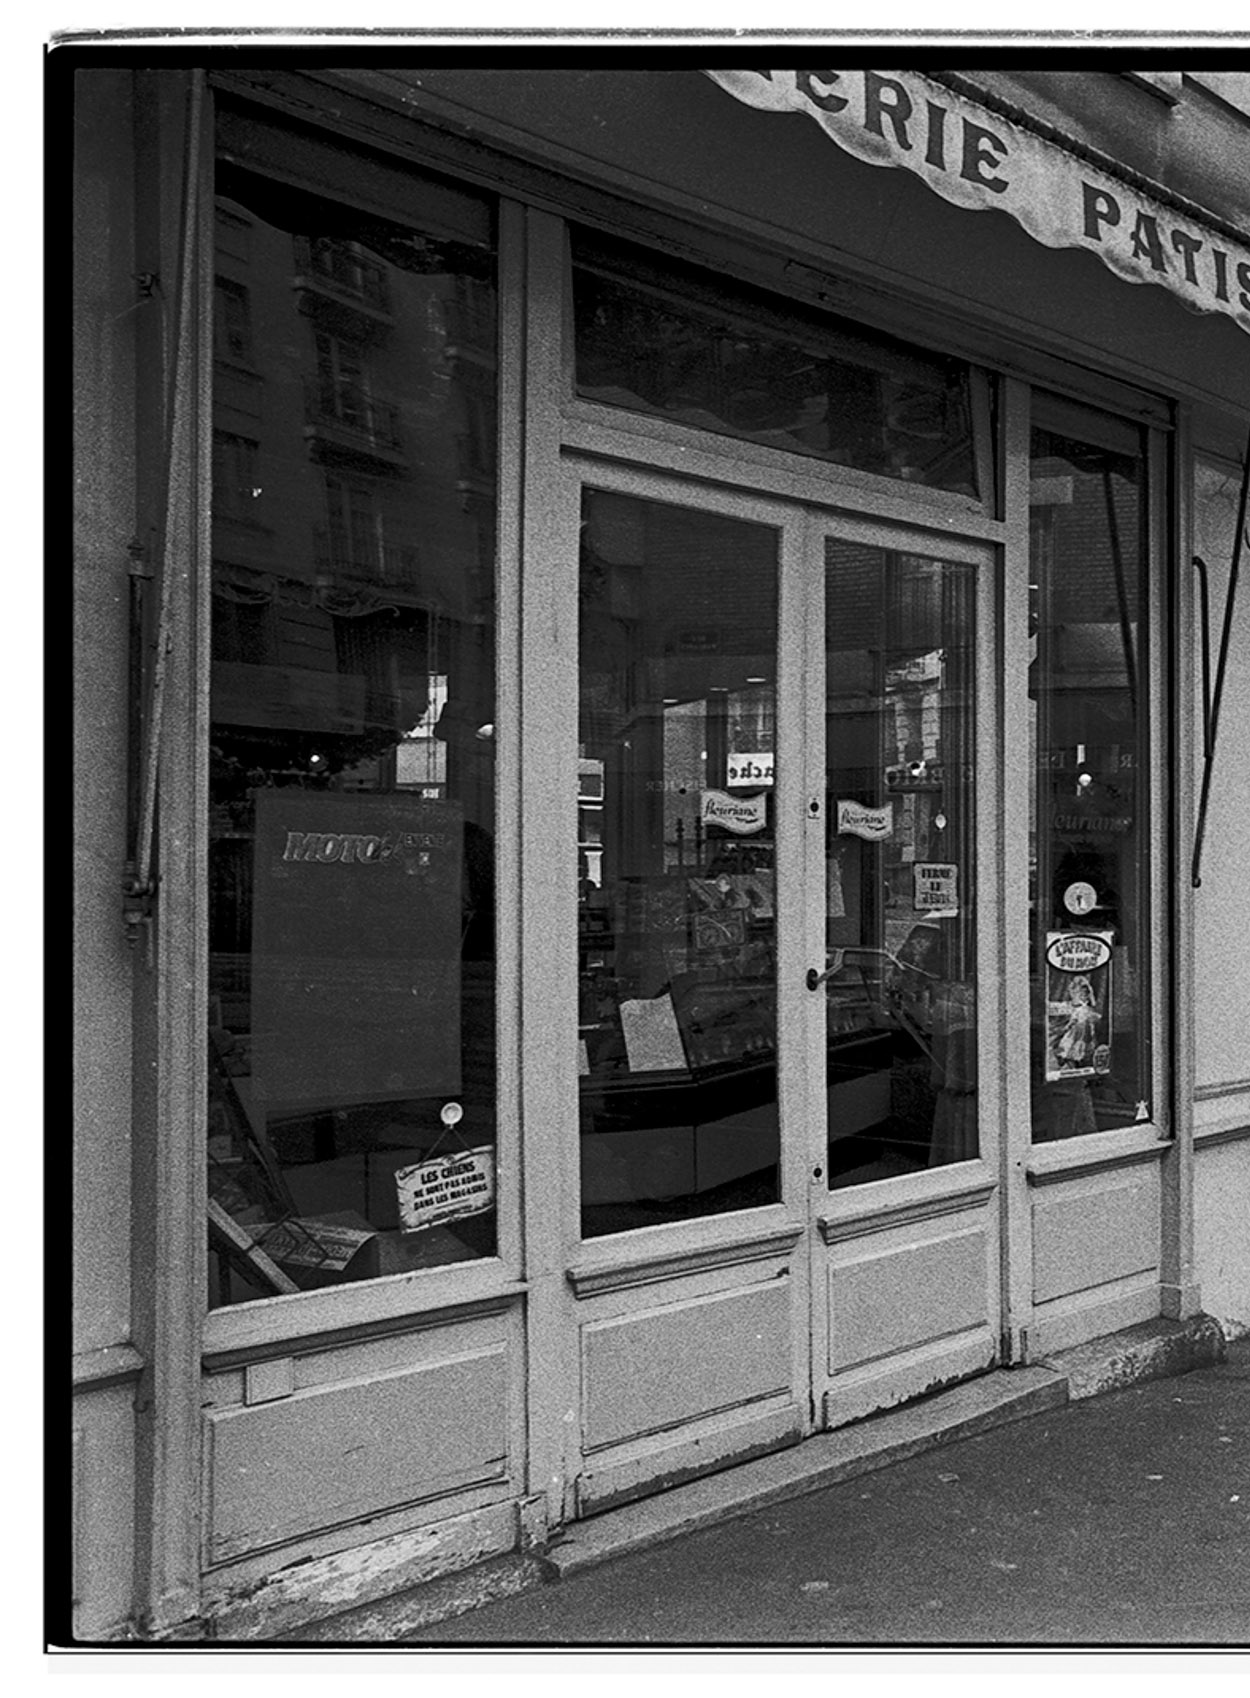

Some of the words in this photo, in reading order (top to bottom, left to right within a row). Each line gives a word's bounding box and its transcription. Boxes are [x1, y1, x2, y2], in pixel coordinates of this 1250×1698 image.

[756, 71, 1009, 194] ERIE
[414, 1188, 424, 1198] NE
[426, 1182, 444, 1195] SONT
[445, 1179, 460, 1190] PAS
[461, 1172, 485, 1185] ADMIS
[421, 1170, 438, 1185] LES
[441, 1161, 475, 1179] CHIENS
[414, 1197, 434, 1211] DANS
[436, 1193, 449, 1204] LES
[450, 1183, 488, 1200] MAGASINS
